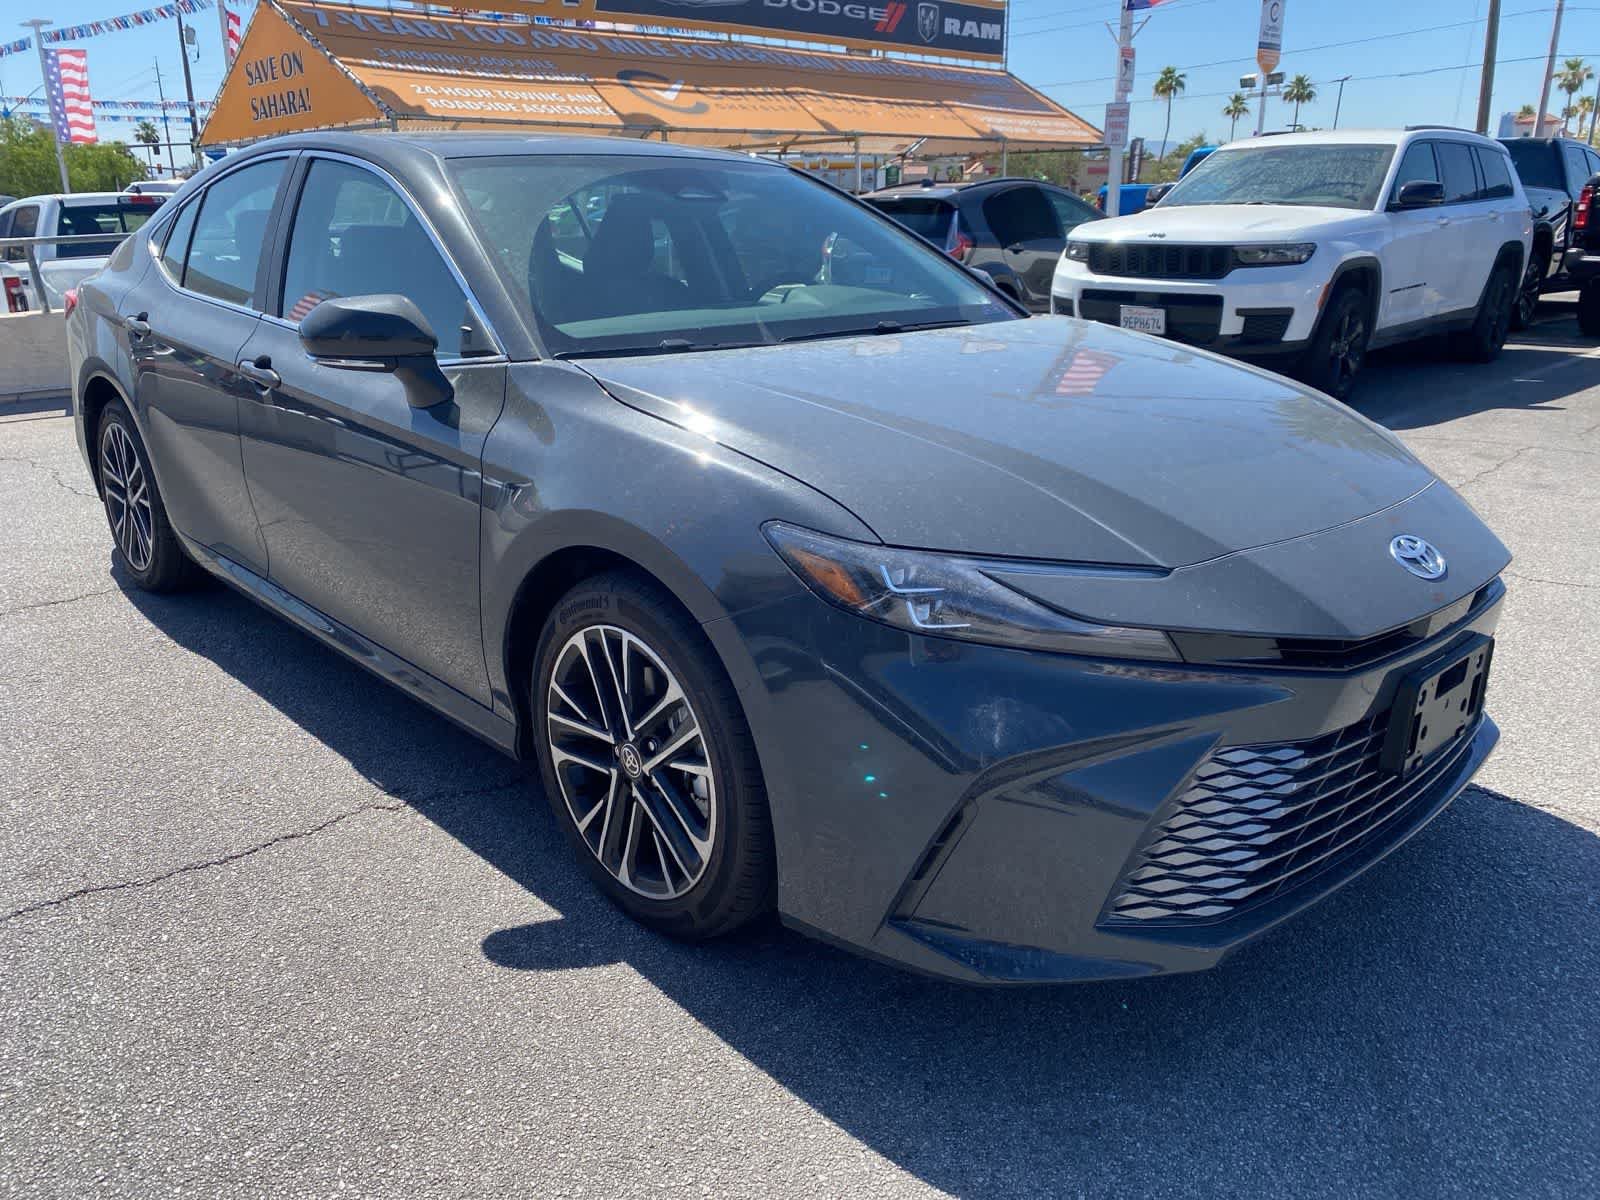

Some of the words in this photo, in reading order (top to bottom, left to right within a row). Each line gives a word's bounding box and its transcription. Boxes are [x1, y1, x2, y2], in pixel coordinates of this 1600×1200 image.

[944, 17, 1001, 40] RAM
[599, 37, 678, 58] MILE
[245, 55, 279, 87] SAVE
[281, 48, 305, 78] ON
[250, 87, 313, 122] SAHARA!
[409, 84, 497, 98] 24-HOUR
[496, 89, 567, 102] TOWING
[566, 93, 603, 104] AND
[426, 97, 522, 113] ROADSIDE
[521, 103, 617, 116] ASSISTANCE
